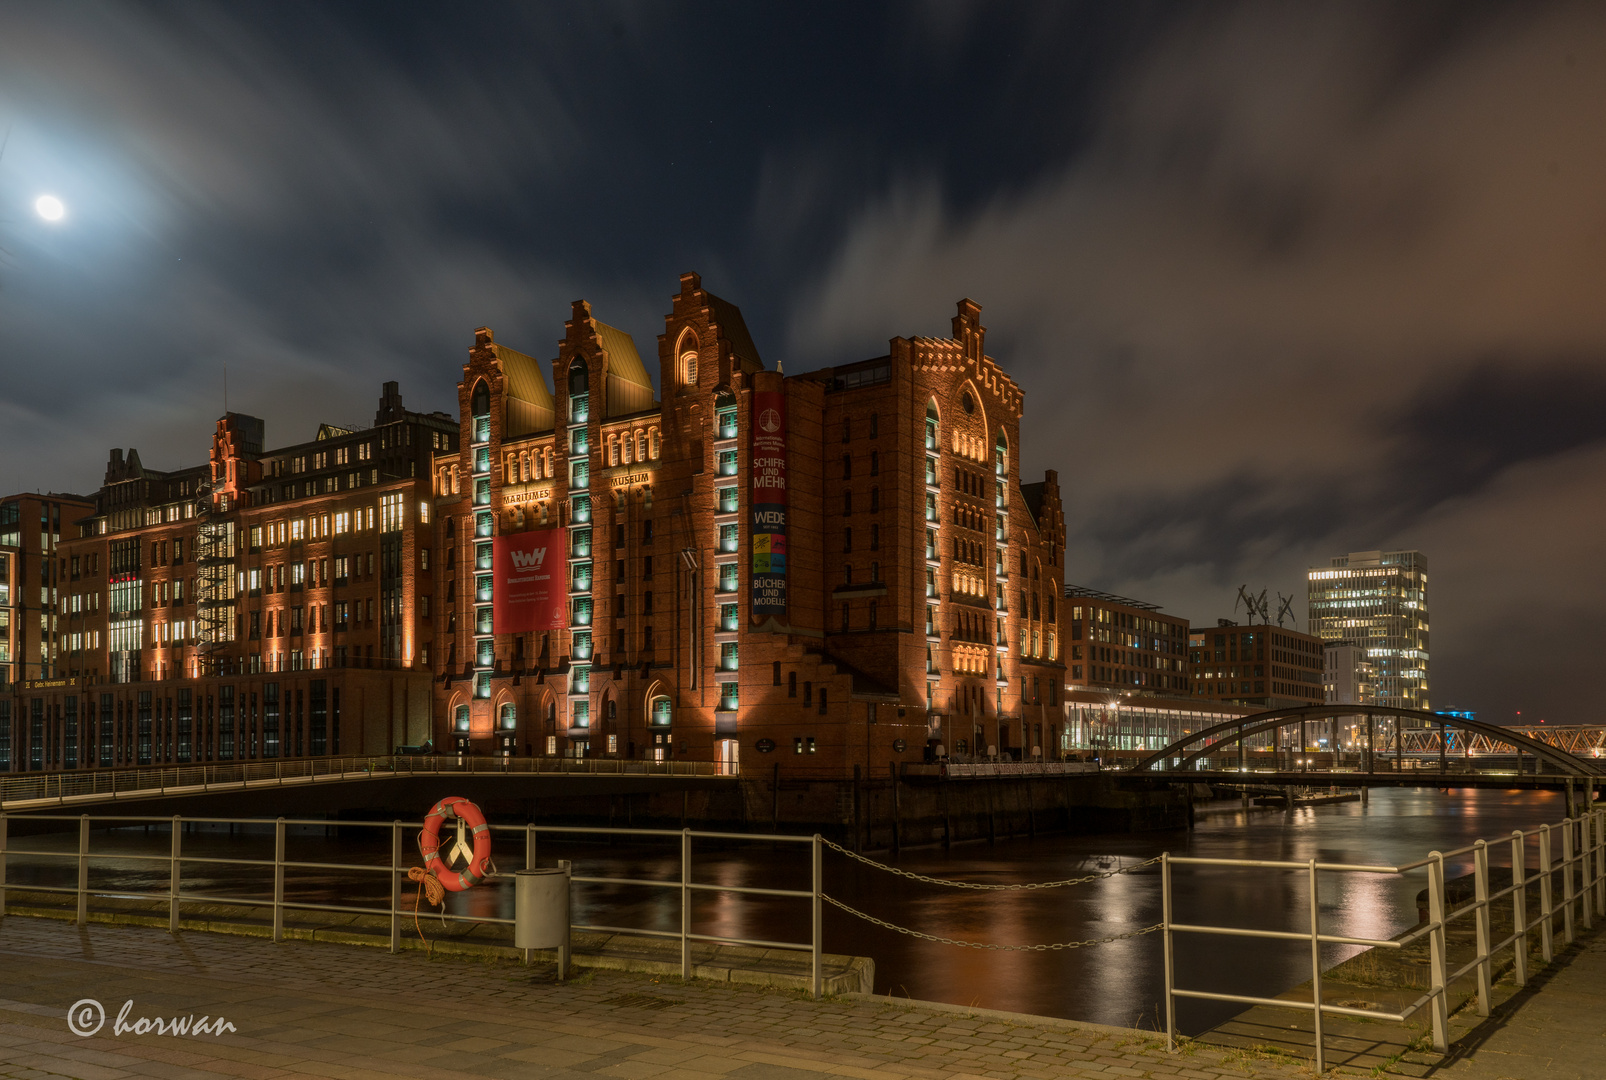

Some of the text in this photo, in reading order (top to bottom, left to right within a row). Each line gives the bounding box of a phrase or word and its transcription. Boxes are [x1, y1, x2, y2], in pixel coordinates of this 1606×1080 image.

[753, 457, 786, 470] SCHIFFE
[762, 468, 779, 476] UND
[610, 472, 649, 487] MUSEUM
[753, 475, 786, 490] MEHR
[503, 489, 549, 504] MARITIMES
[754, 511, 785, 525] WEDE
[753, 576, 786, 589] BÜCHER
[762, 589, 779, 597] UND
[753, 597, 786, 606] MODELLE
